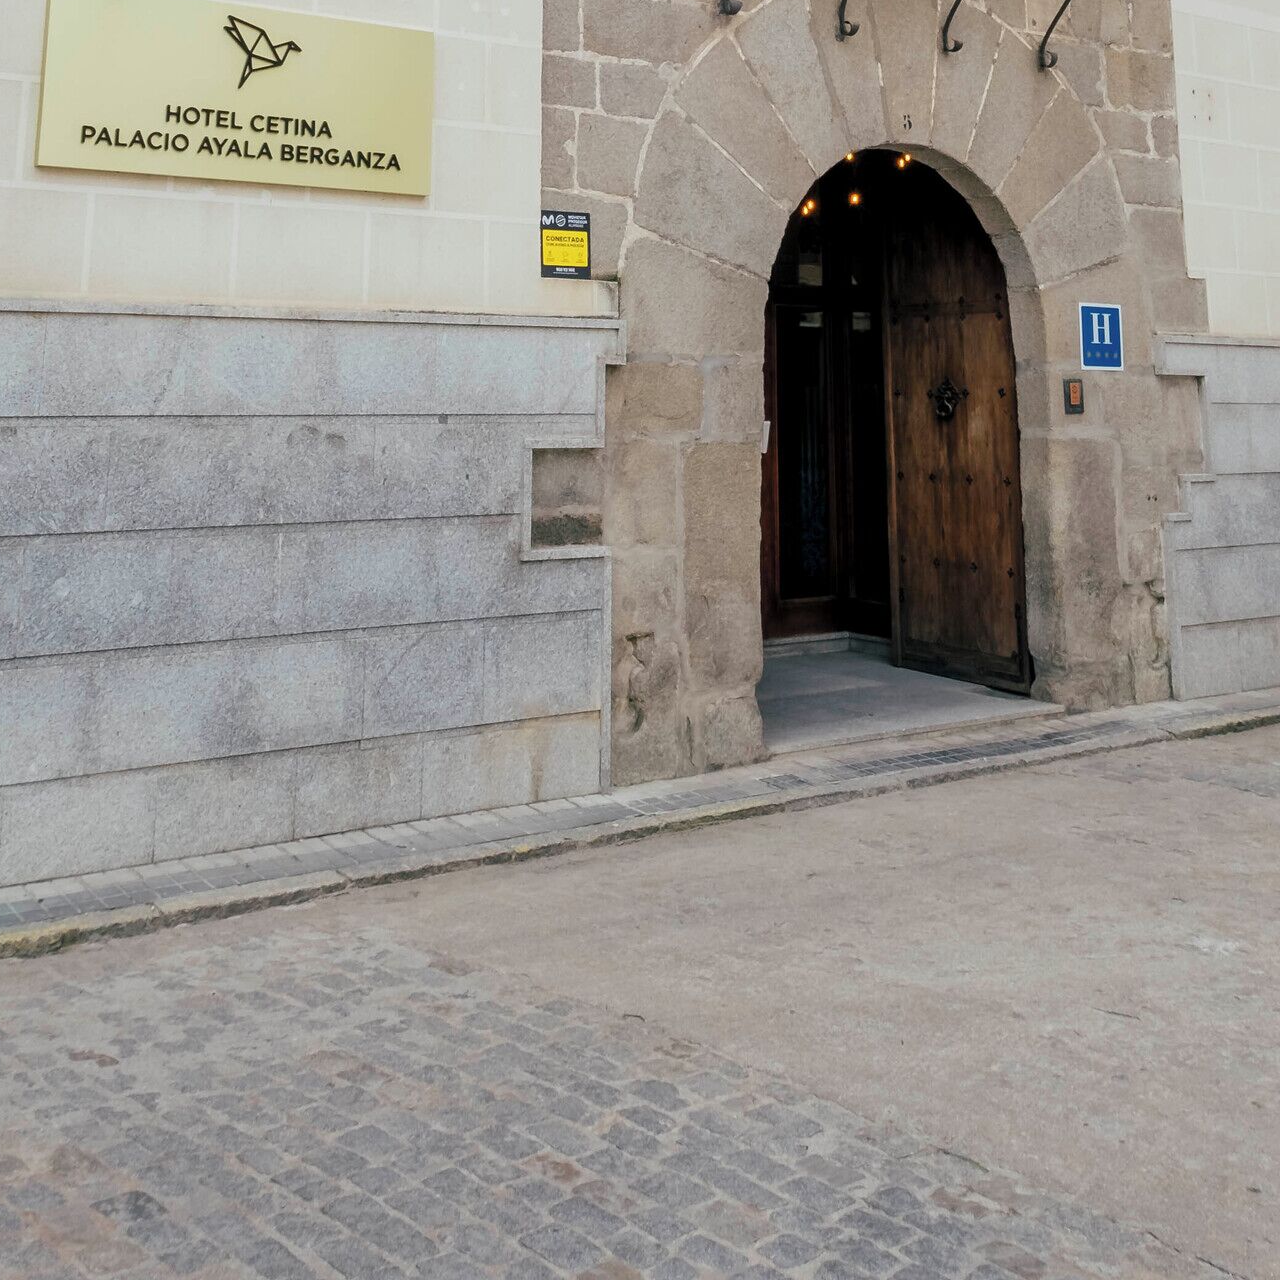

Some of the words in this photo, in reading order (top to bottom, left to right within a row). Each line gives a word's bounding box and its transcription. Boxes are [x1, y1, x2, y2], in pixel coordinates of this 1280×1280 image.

[165, 104, 243, 130] HOTEL
[249, 114, 333, 139] CETINA
[80, 125, 189, 152] PALACIO
[197, 136, 273, 160] AYALA
[280, 144, 401, 171] BERGANZA
[1090, 312, 1113, 345] H
